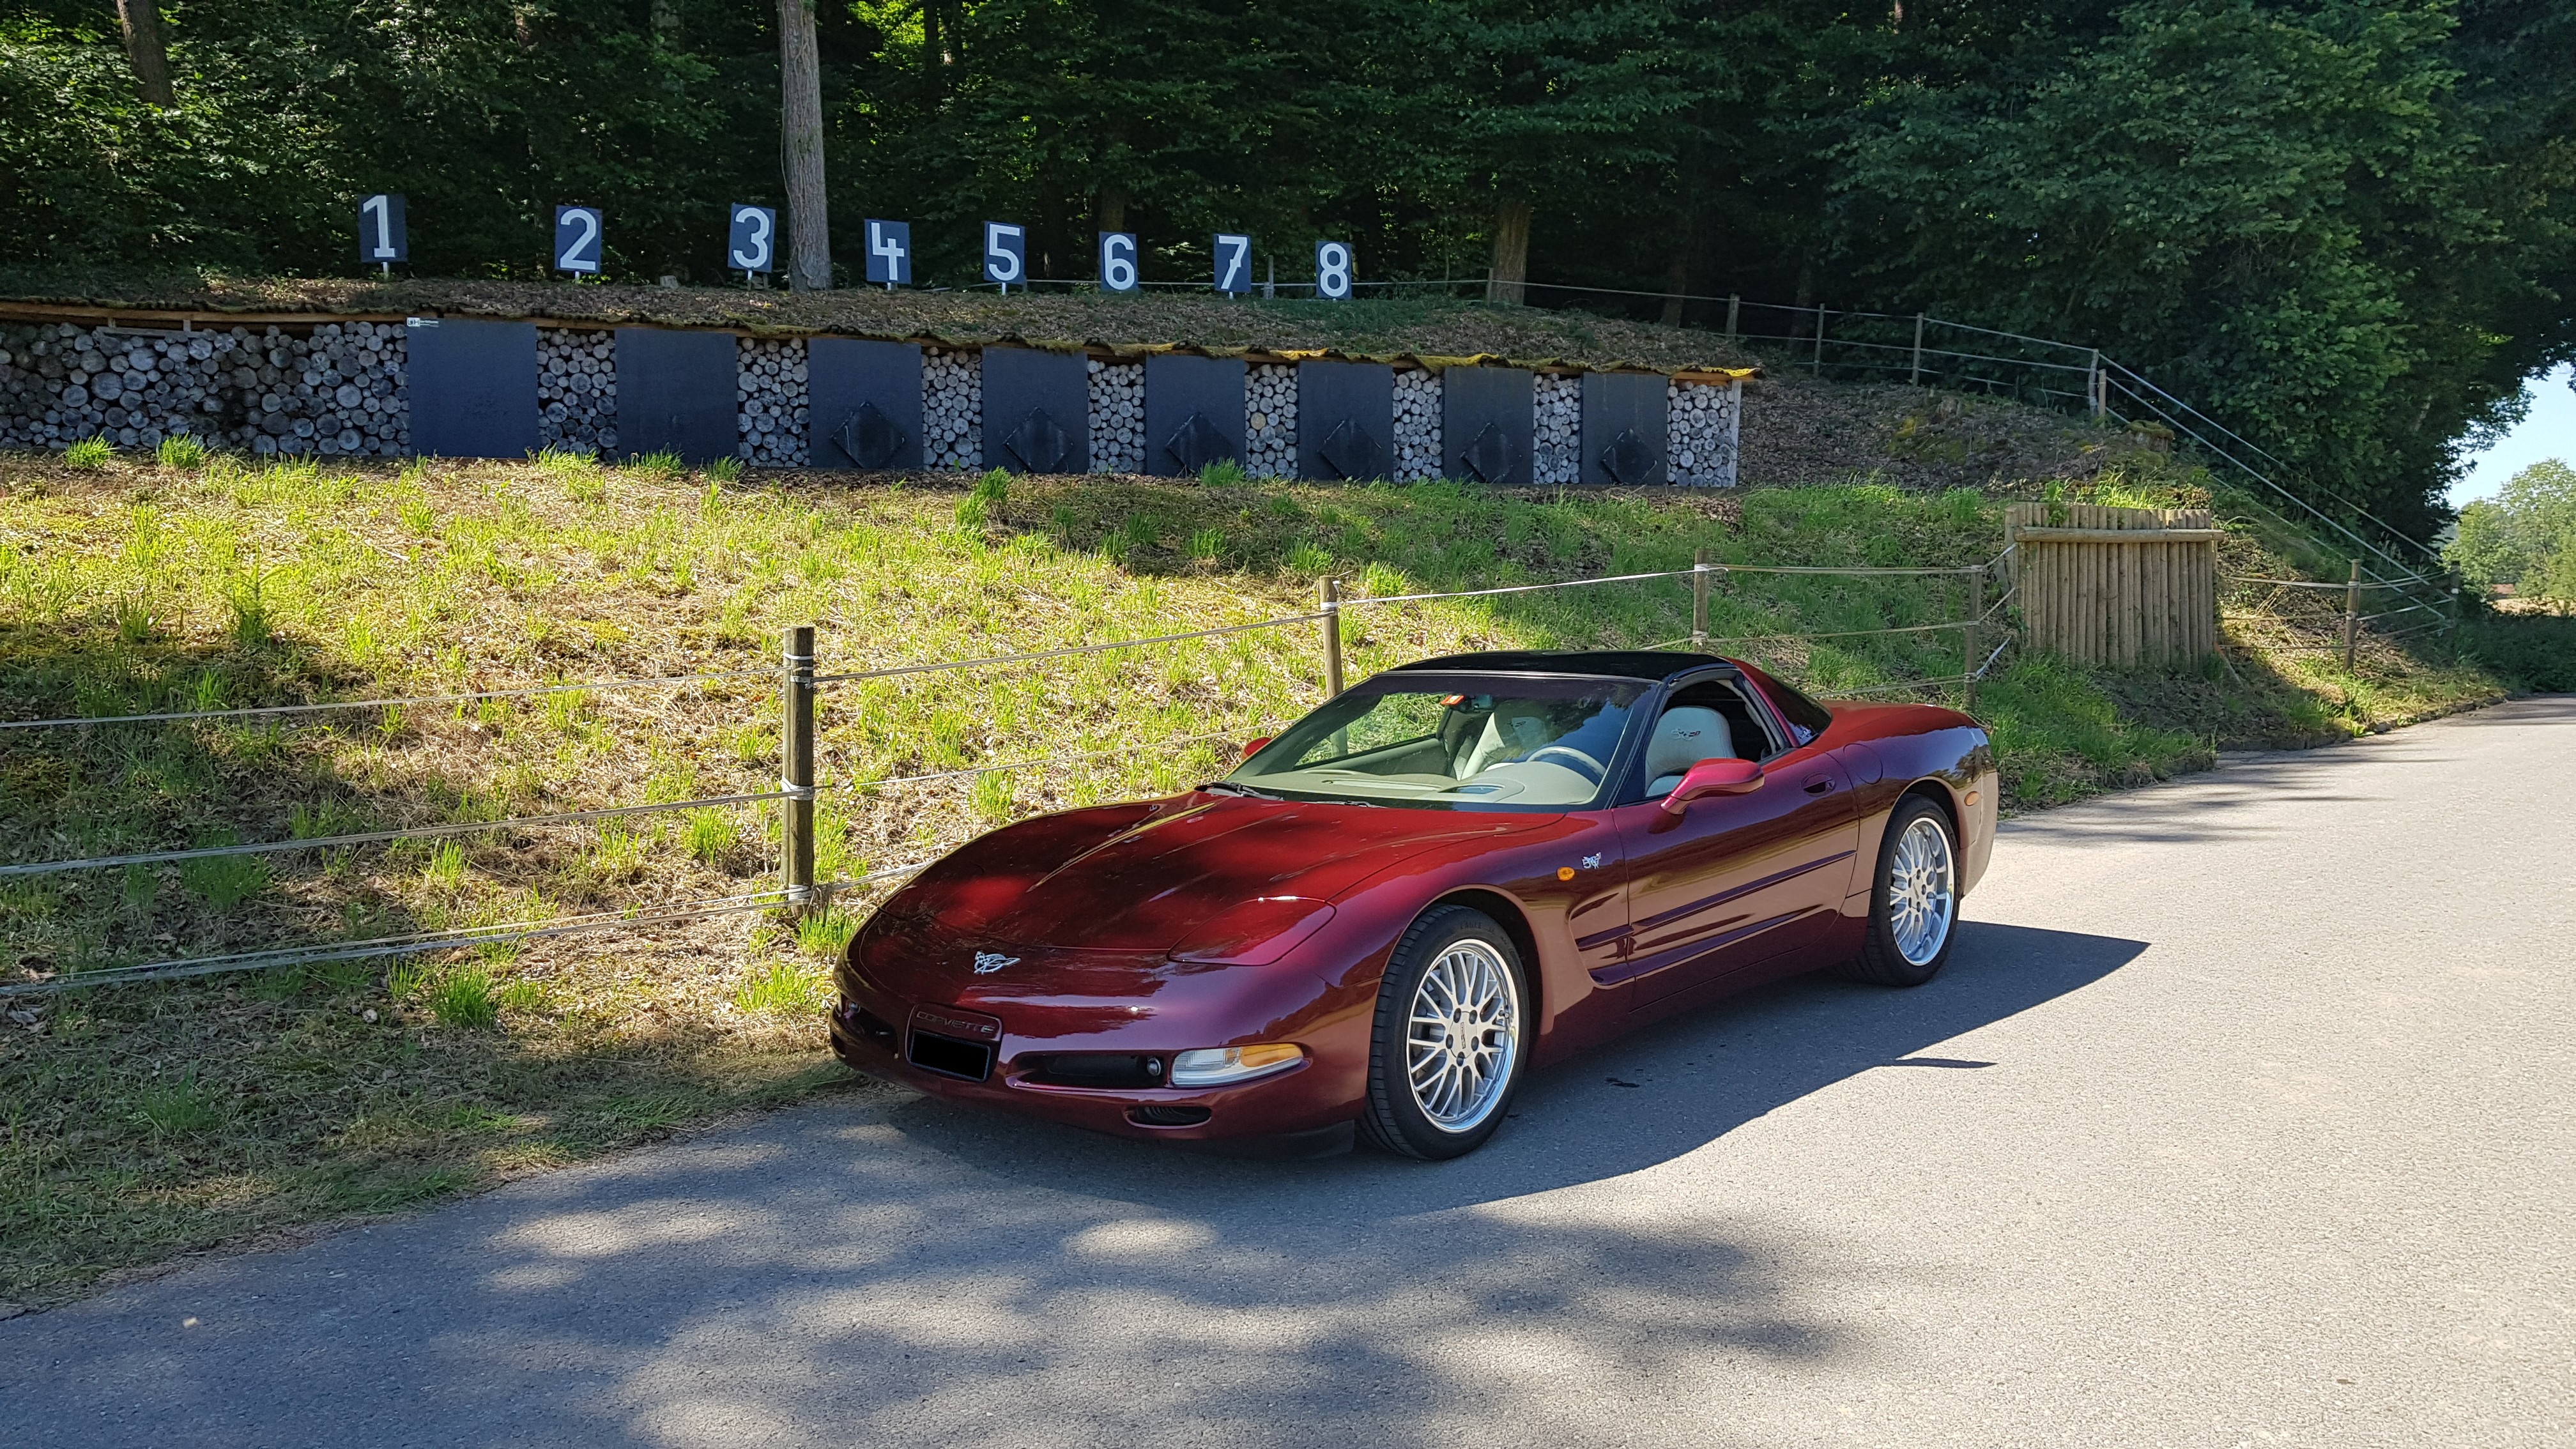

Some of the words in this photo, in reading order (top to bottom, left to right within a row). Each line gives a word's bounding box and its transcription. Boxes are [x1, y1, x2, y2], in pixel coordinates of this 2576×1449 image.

[364, 195, 395, 257] 1
[560, 209, 596, 271] 2
[733, 207, 770, 268] 3
[871, 222, 905, 281] 4
[988, 224, 1020, 281] 5
[1104, 234, 1135, 291] 6
[1218, 235, 1248, 289] 7
[1319, 243, 1348, 297] 8
[916, 1011, 995, 1033] CORVETTE
